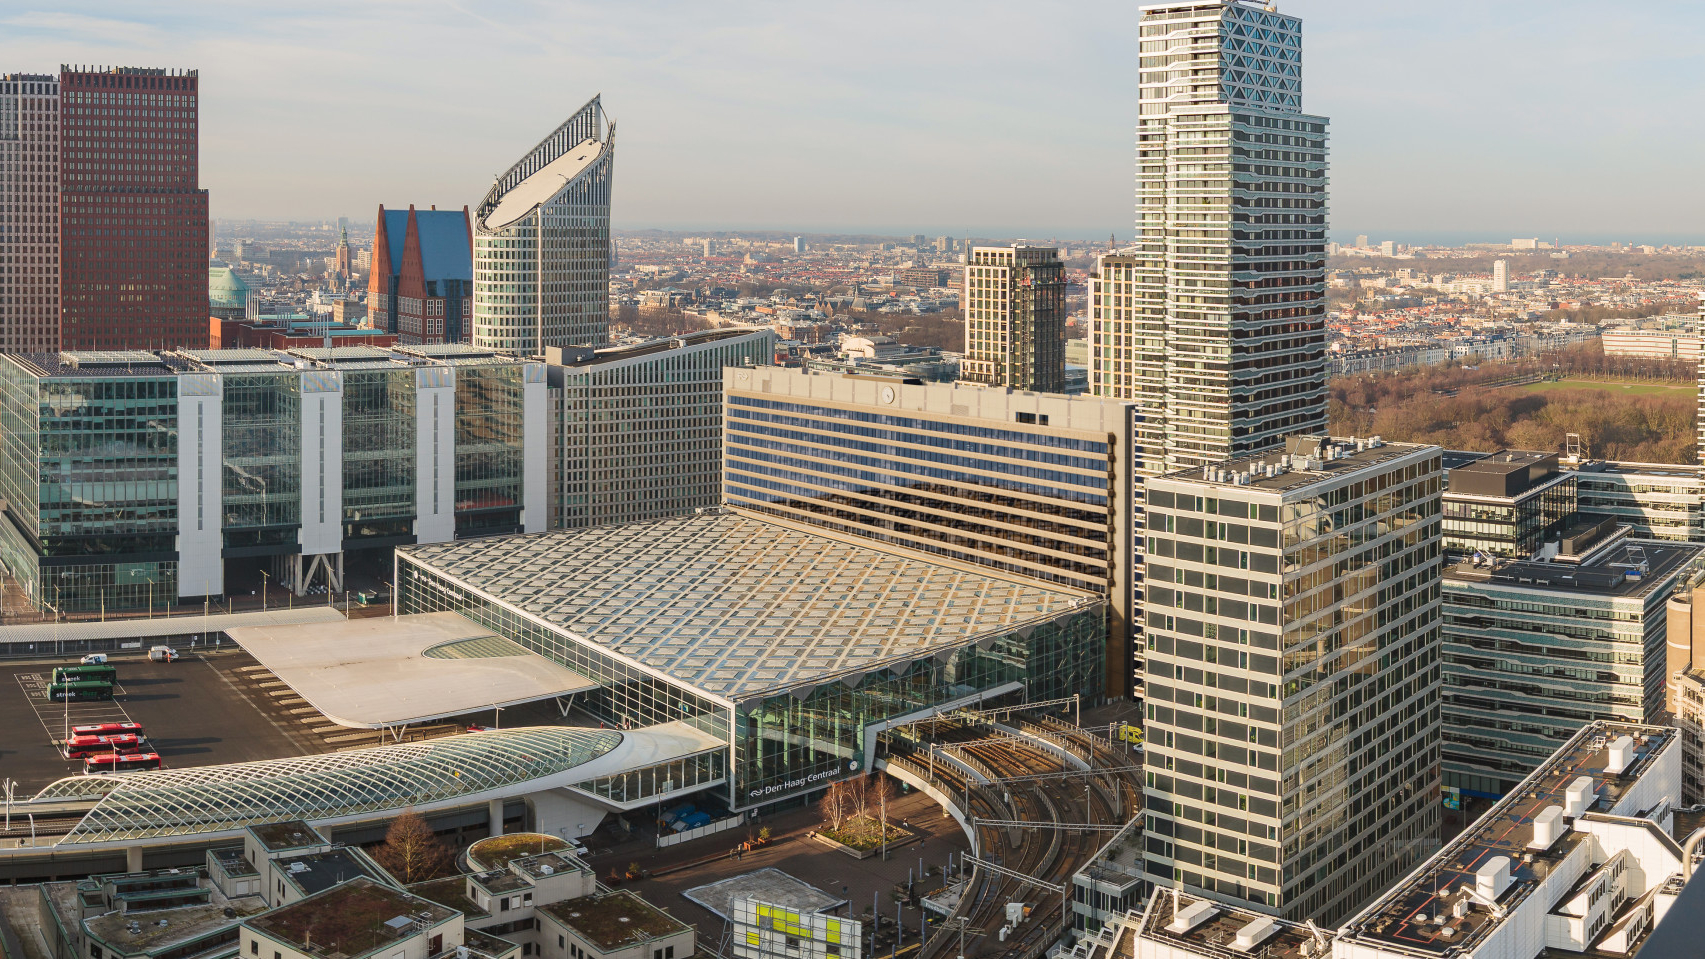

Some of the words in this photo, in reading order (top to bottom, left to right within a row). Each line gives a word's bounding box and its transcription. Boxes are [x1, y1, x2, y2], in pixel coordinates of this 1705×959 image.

[765, 785, 782, 794] Den
[784, 777, 806, 789] Haag
[807, 766, 840, 782] Centraal
